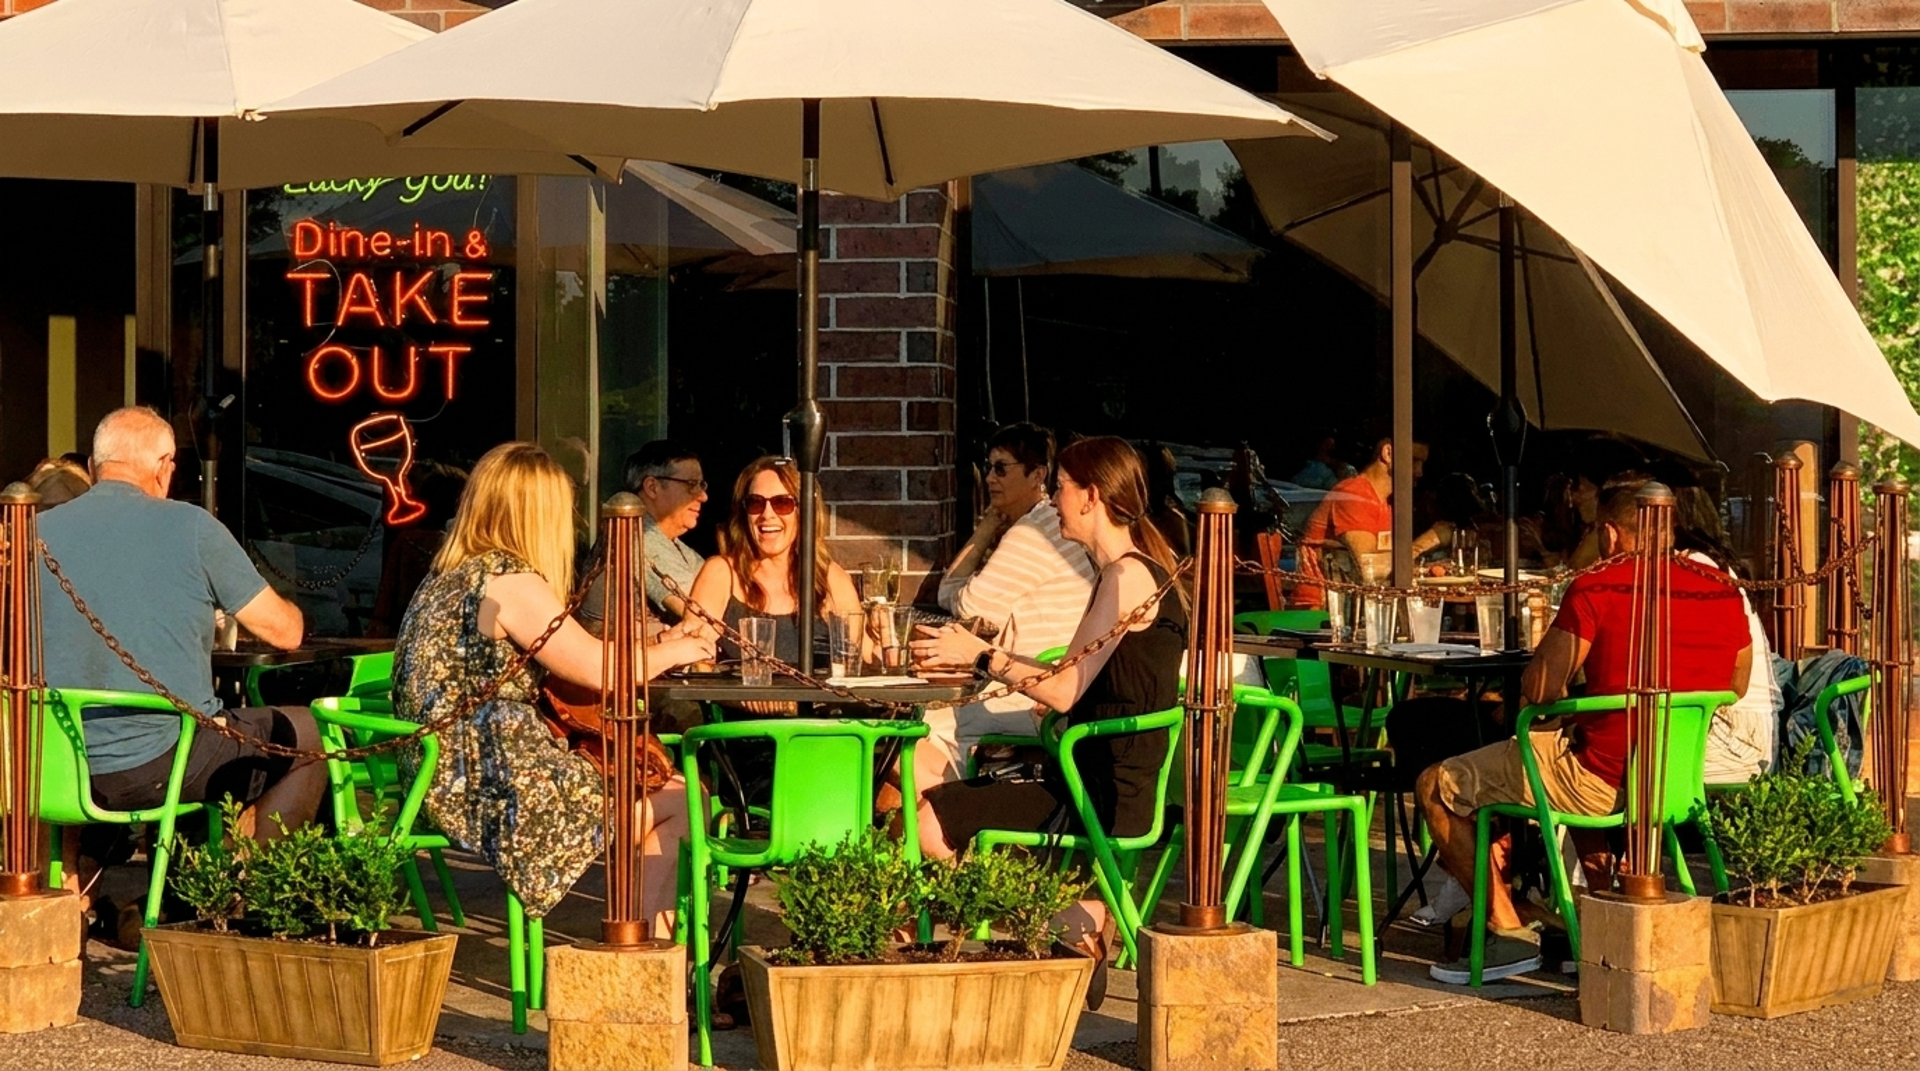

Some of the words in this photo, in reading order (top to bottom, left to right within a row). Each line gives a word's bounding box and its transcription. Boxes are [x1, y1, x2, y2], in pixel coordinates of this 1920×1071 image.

[294, 221, 450, 257] Dine-in
[465, 230, 487, 259] &
[286, 271, 493, 327] TAKE
[308, 346, 471, 399] OUT
